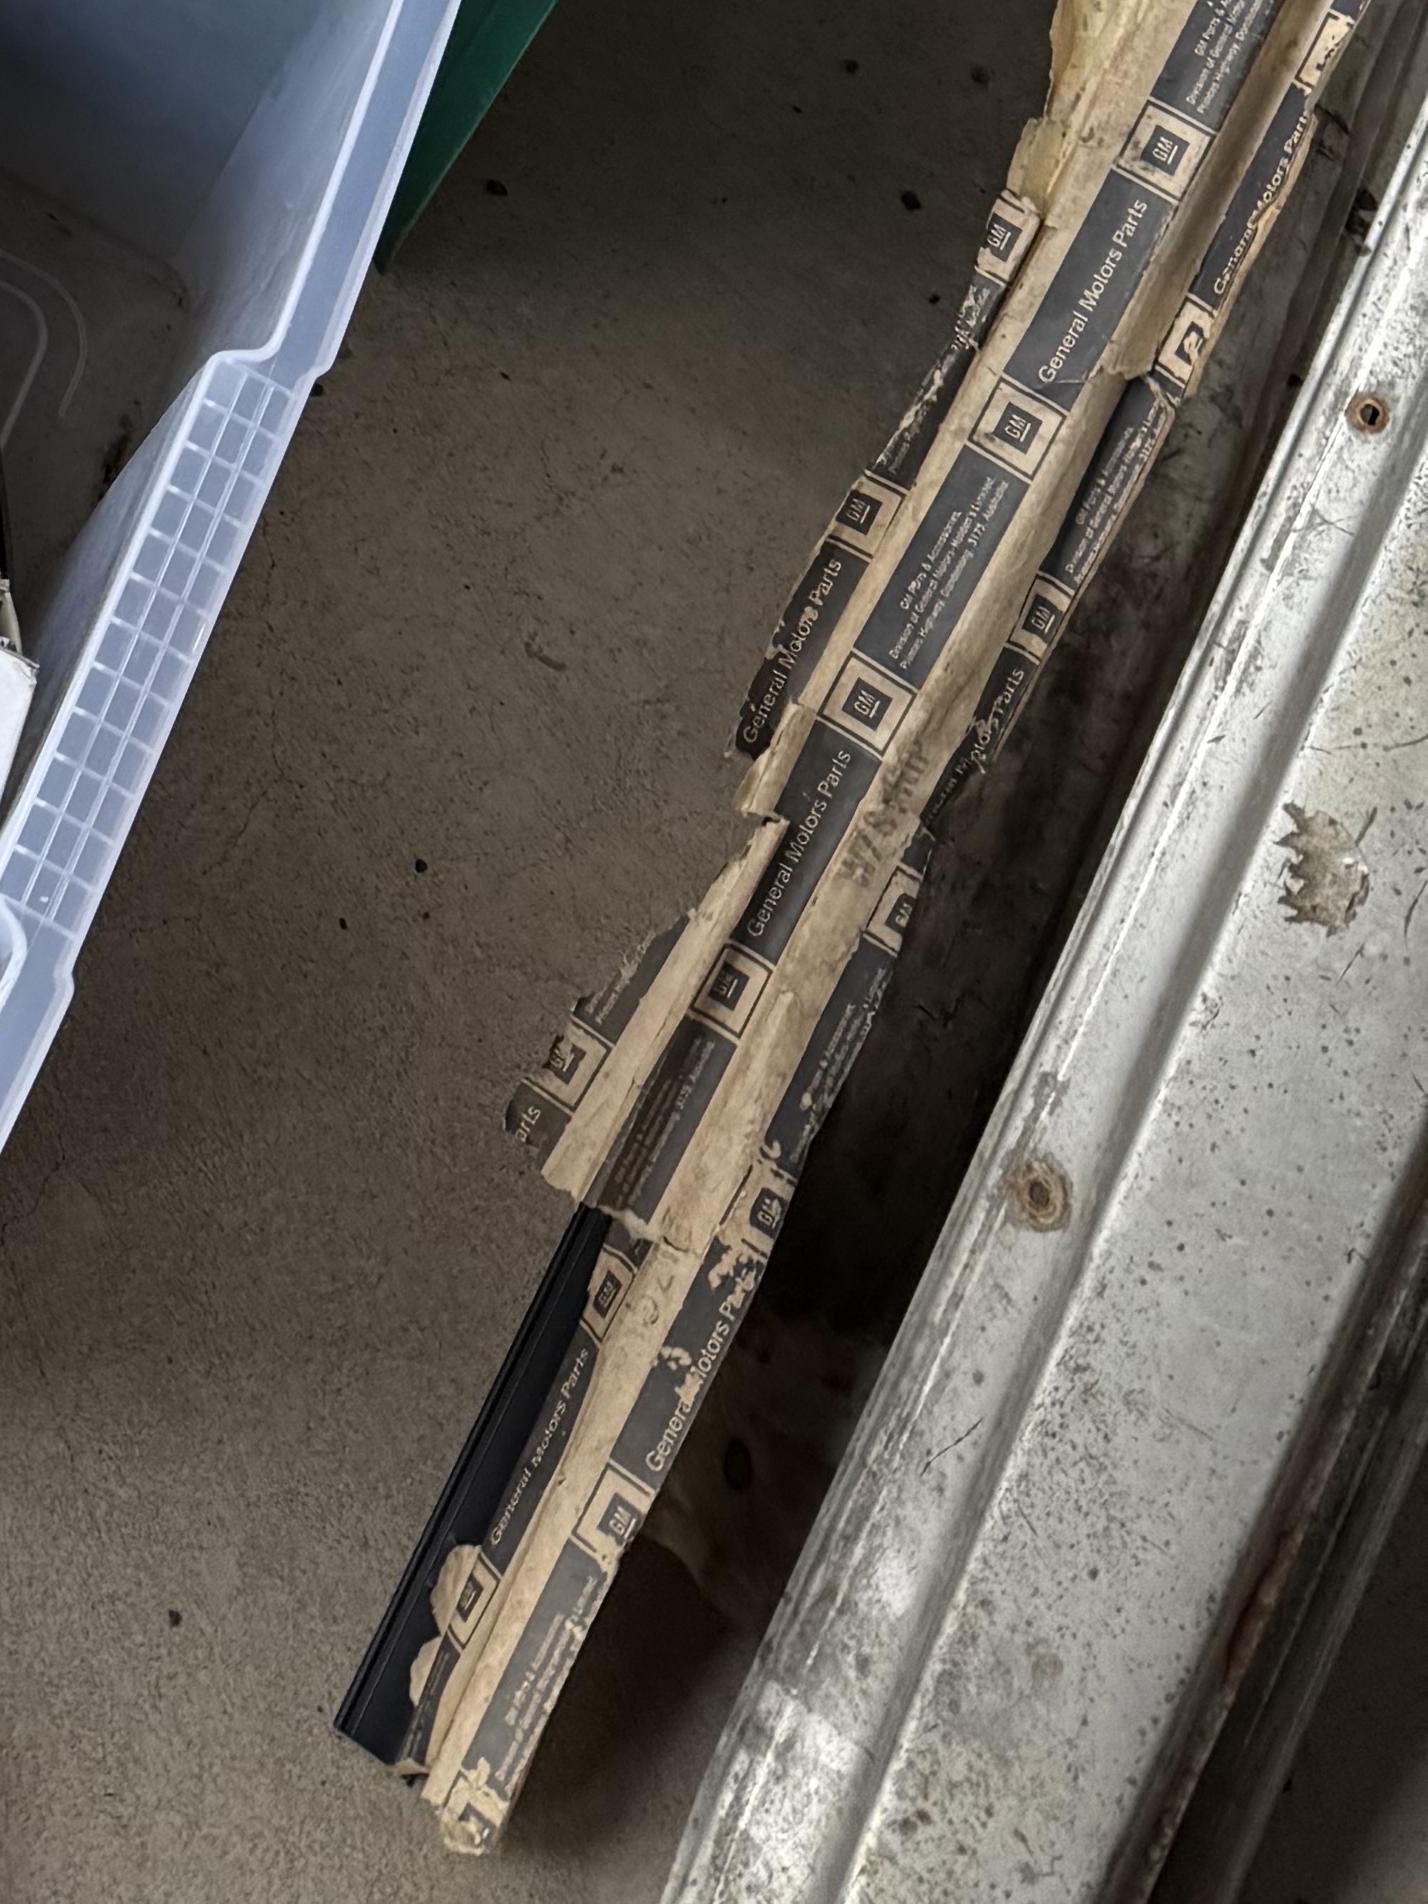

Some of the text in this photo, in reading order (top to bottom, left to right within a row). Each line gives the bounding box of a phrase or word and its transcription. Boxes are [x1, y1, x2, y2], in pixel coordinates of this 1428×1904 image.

[1203, 55, 1217, 70] of
[1149, 134, 1180, 166] GM
[981, 220, 1012, 251] GM
[1035, 196, 1149, 385] General Motors Parts
[1002, 412, 1033, 443] GM
[843, 495, 872, 525] GM
[907, 610, 921, 623] of
[1028, 603, 1057, 633] GM
[739, 669, 788, 744] General
[807, 556, 843, 606] Parts
[852, 689, 882, 718] GM
[743, 747, 853, 938] General Motors Parts
[488, 1346, 592, 1545] General Motors Parts
[605, 1504, 639, 1539] GM
